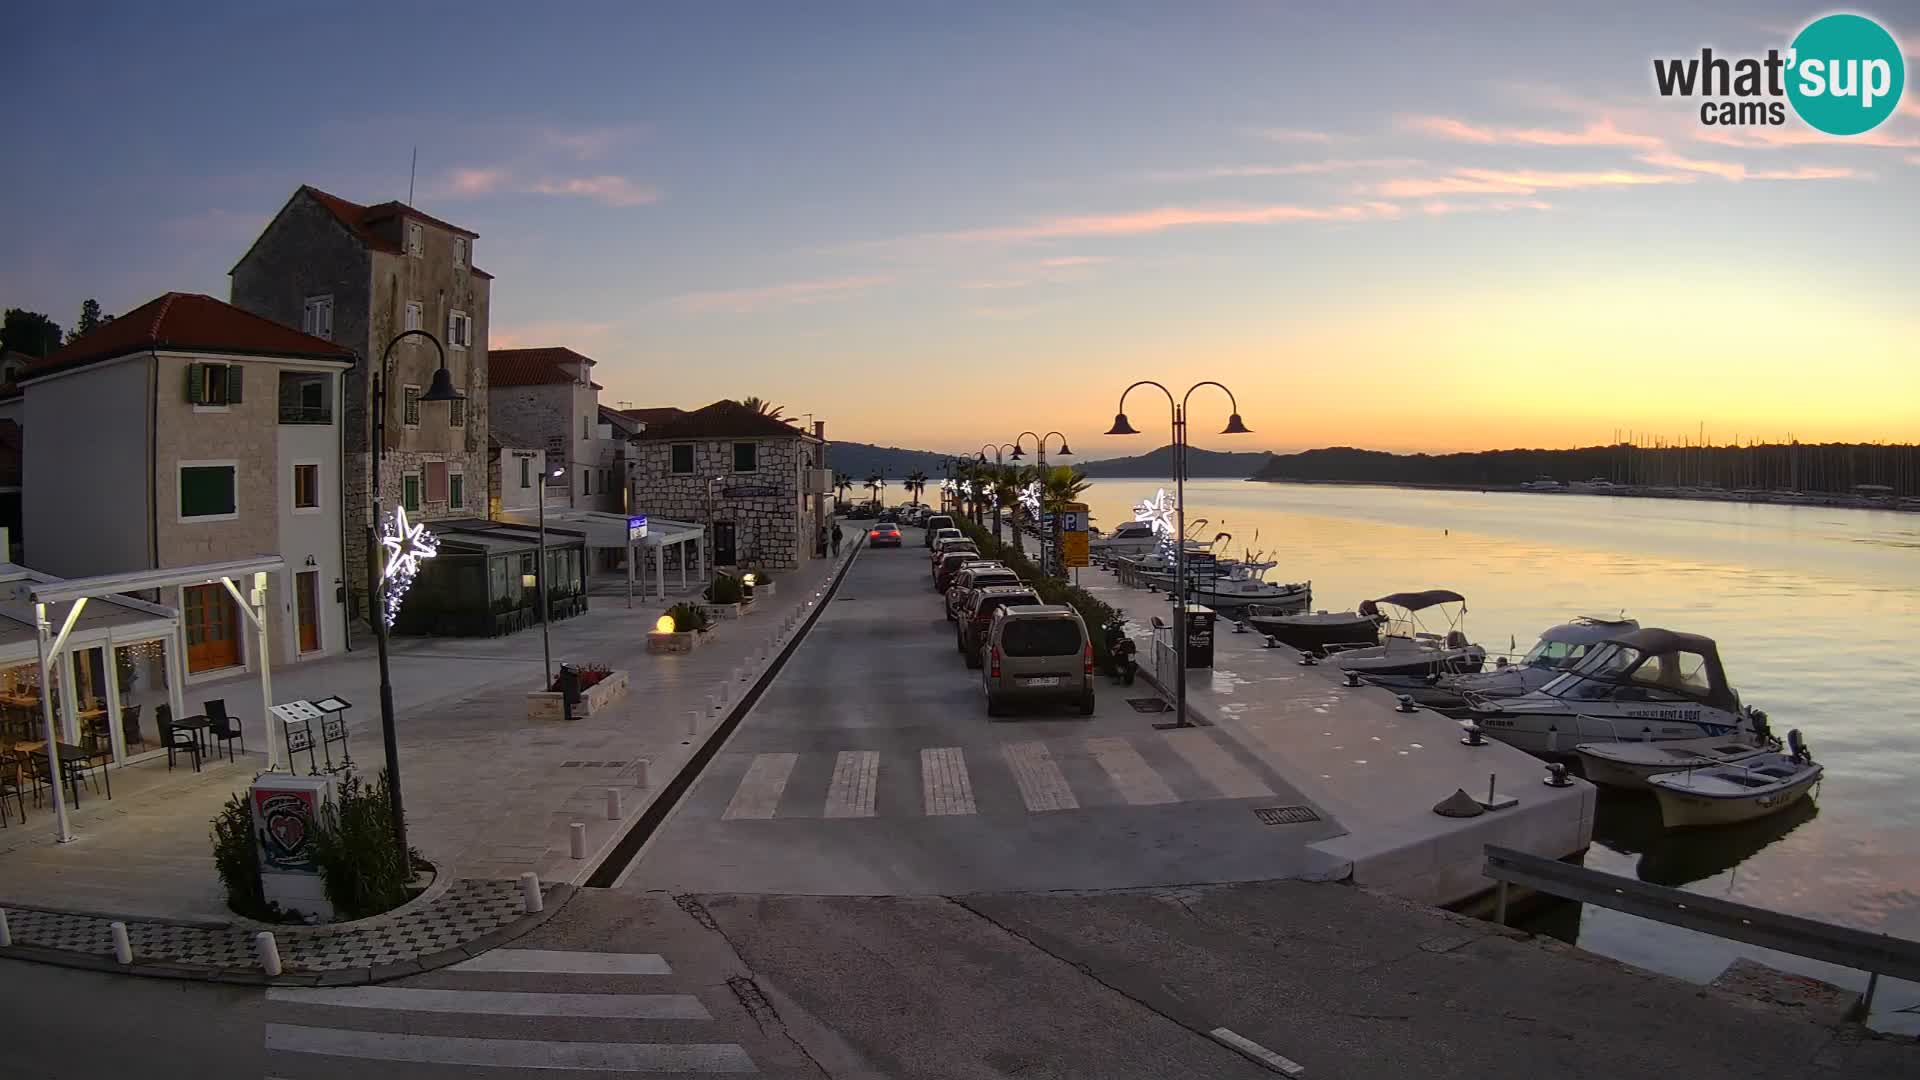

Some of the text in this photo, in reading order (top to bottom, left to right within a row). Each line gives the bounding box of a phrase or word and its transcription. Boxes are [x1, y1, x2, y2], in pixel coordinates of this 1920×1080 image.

[1065, 514, 1076, 530] P
[1660, 710, 1678, 720] RENT
[1684, 710, 1701, 720] BOAT
